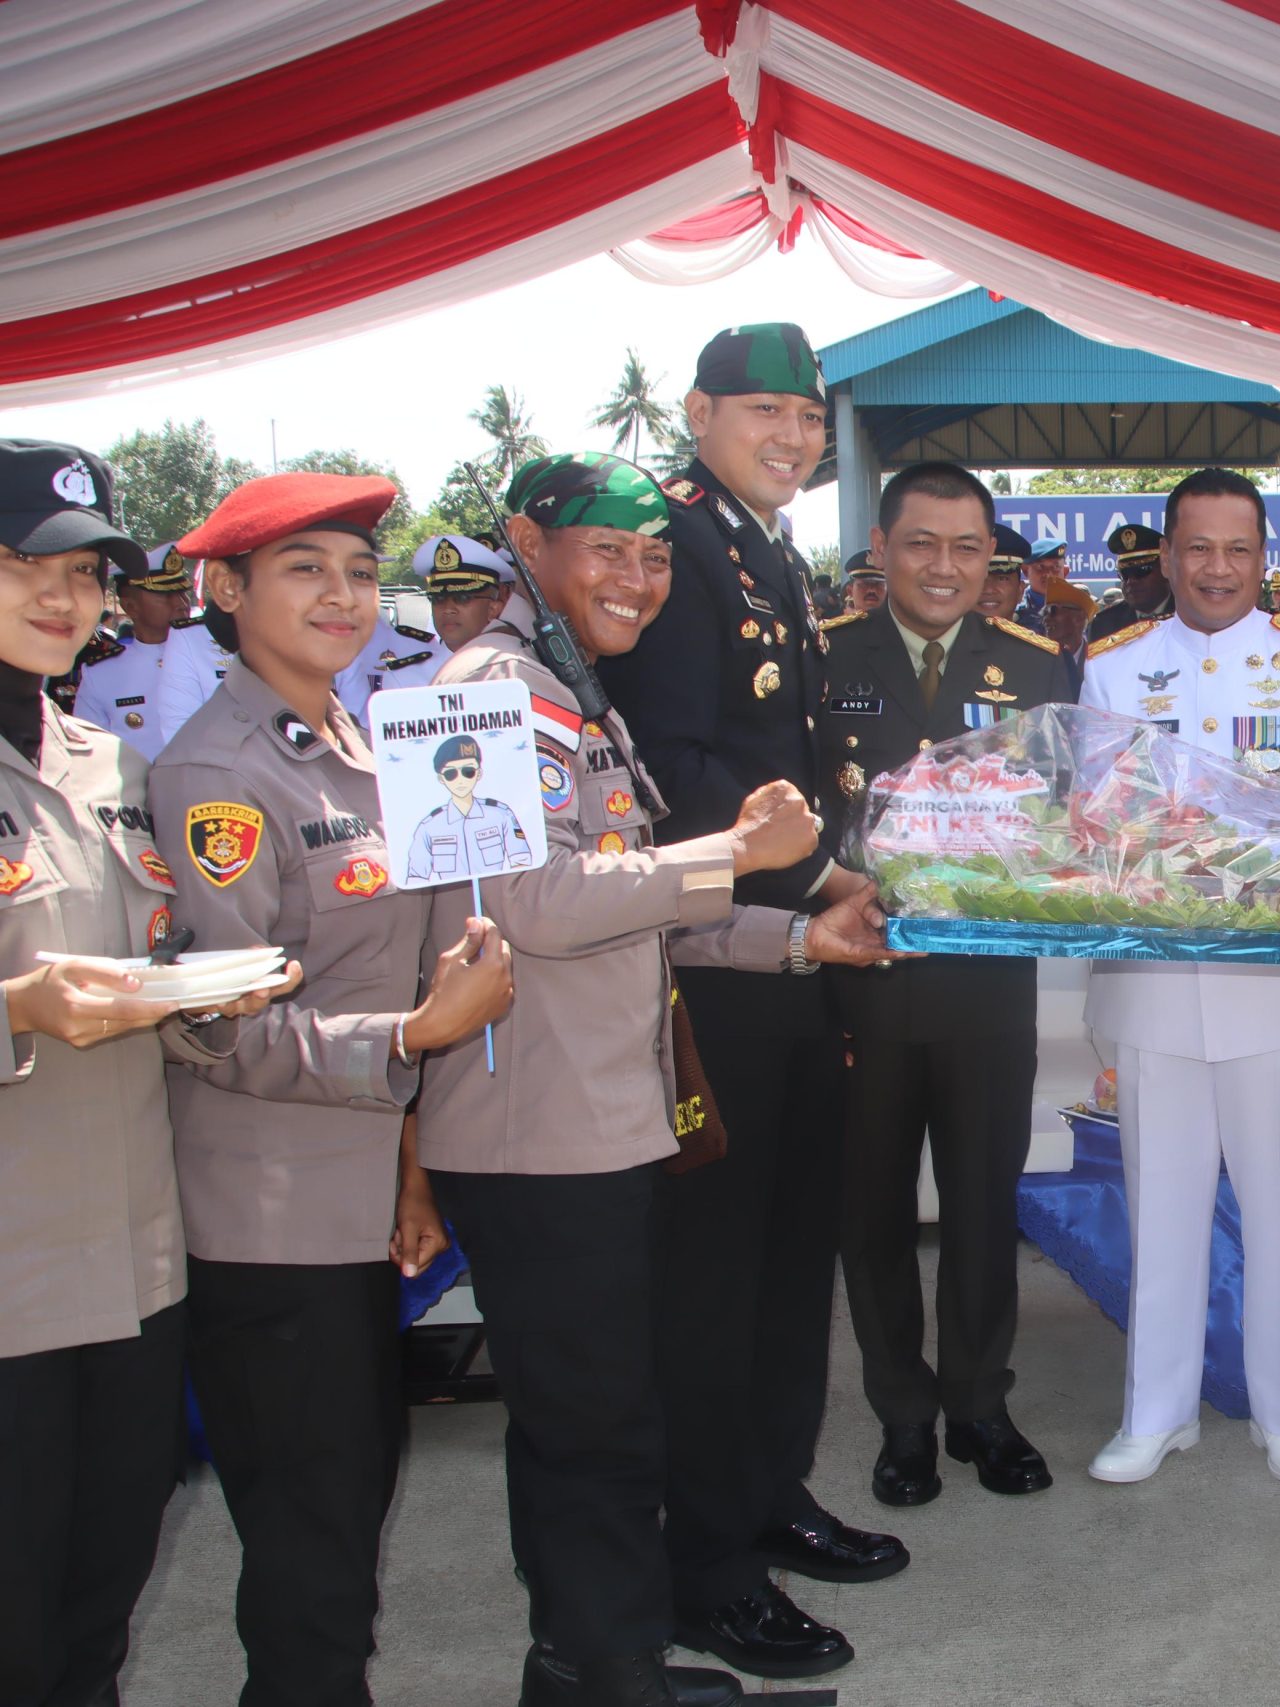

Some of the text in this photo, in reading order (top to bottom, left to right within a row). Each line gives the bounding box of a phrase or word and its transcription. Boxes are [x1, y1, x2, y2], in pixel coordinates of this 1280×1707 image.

[1002, 513, 1085, 542] TNI
[438, 693, 465, 713] TNI
[842, 701, 870, 709] ANDY
[383, 709, 523, 741] MENANTU IDAMAN
[193, 805, 259, 822] BARESKRIM
